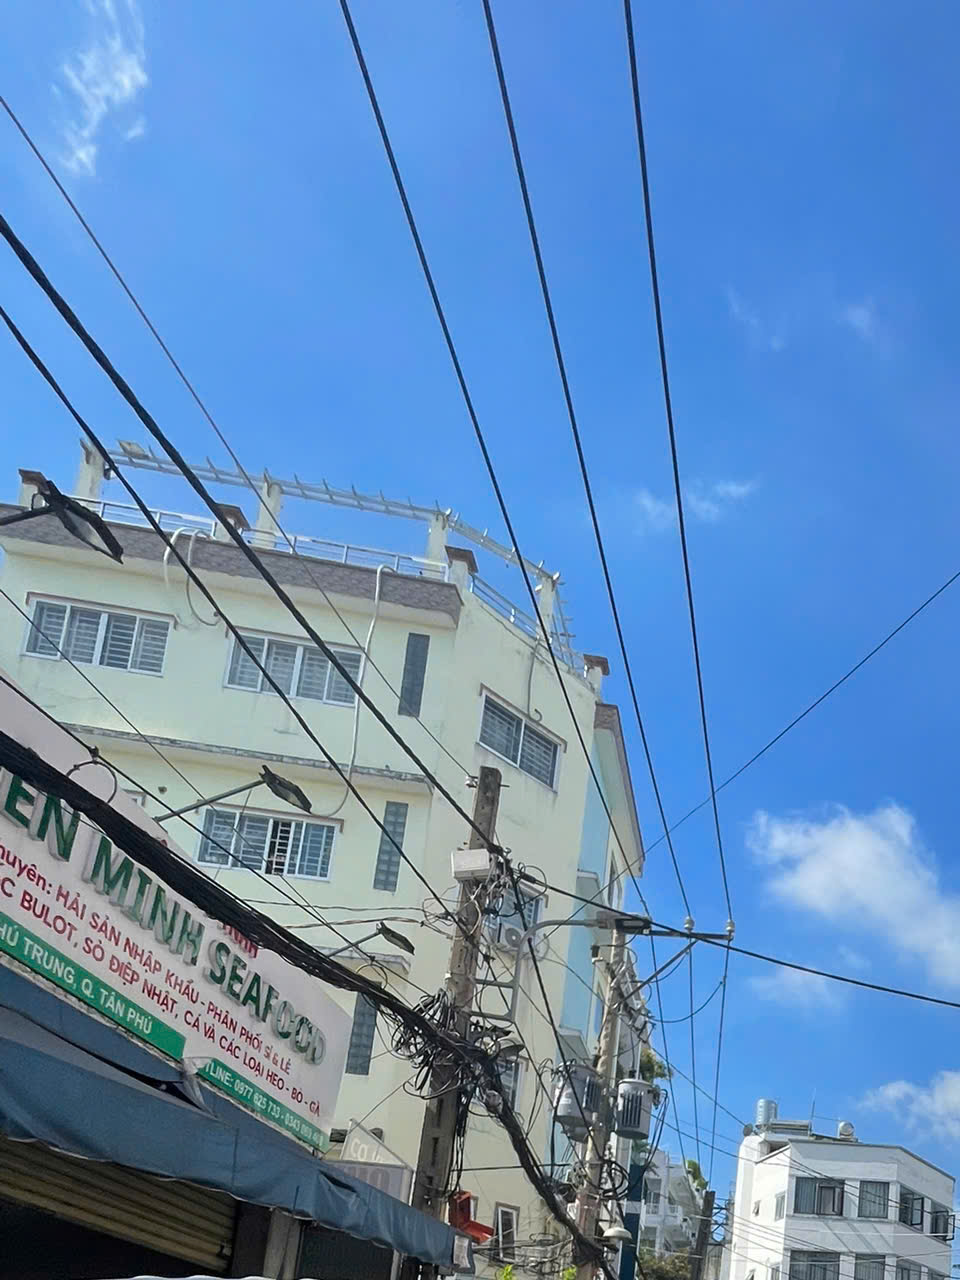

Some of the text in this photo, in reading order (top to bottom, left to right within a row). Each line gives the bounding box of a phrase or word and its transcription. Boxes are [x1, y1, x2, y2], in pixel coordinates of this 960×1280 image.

[56, 884, 87, 920] HẢI
[89, 912, 121, 947] SẢN
[124, 937, 162, 974] NHẬP
[207, 1001, 237, 1034] PHÂN
[82, 978, 95, 999] Q.
[100, 987, 126, 1018] TÂN
[127, 1006, 153, 1035] PHÚ
[83, 832, 205, 966] MINH
[204, 939, 326, 1066] SEAFOOD
[109, 954, 140, 985] ĐIỆP
[184, 1010, 202, 1032] CÁ
[203, 1021, 216, 1044] VÀ
[219, 1034, 241, 1059] CÁC
[243, 1056, 264, 1079] LOẠI
[266, 1071, 285, 1091] HEO
[291, 1086, 304, 1104] BÒ
